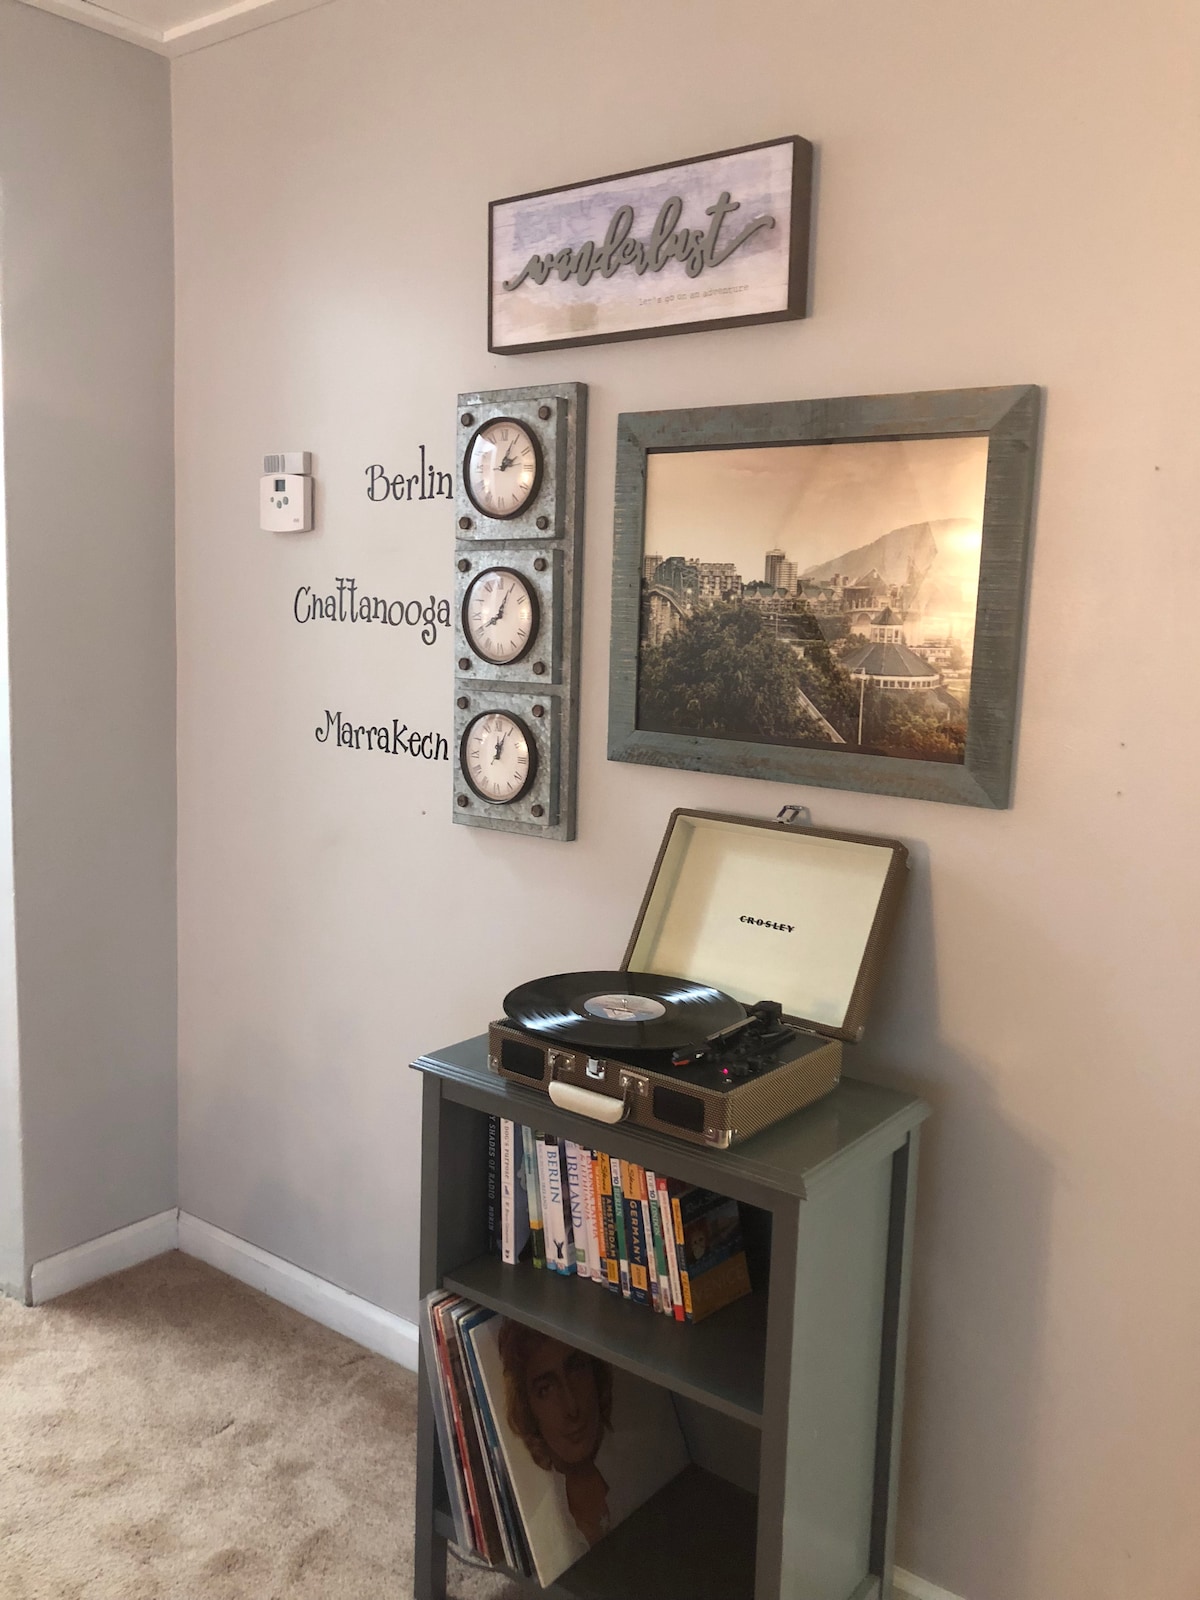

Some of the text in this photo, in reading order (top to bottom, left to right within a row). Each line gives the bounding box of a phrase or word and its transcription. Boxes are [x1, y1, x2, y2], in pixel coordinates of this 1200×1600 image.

[502, 190, 776, 292] wanderlust
[677, 293, 687, 301] on
[689, 291, 700, 300] an
[702, 284, 750, 298] adventure
[365, 444, 454, 502] Berlin
[293, 576, 452, 646] Chattanooga
[738, 915, 795, 933] CROSLEY
[488, 1123, 496, 1158] SHADES
[488, 1159, 496, 1171] OF
[546, 1150, 561, 1204] BERLIN
[613, 1176, 620, 1185] 10
[487, 1172, 496, 1200] RADIO
[566, 1155, 583, 1229] IRELAND
[580, 1164, 590, 1220] LITHUANIA
[613, 1186, 622, 1217] BERLIN
[649, 1190, 656, 1199] 10
[606, 1198, 616, 1257] AMSTERDAM
[629, 1200, 642, 1264] GERMANY
[651, 1201, 661, 1236] LONDON
[681, 1274, 692, 1310] VENICE
